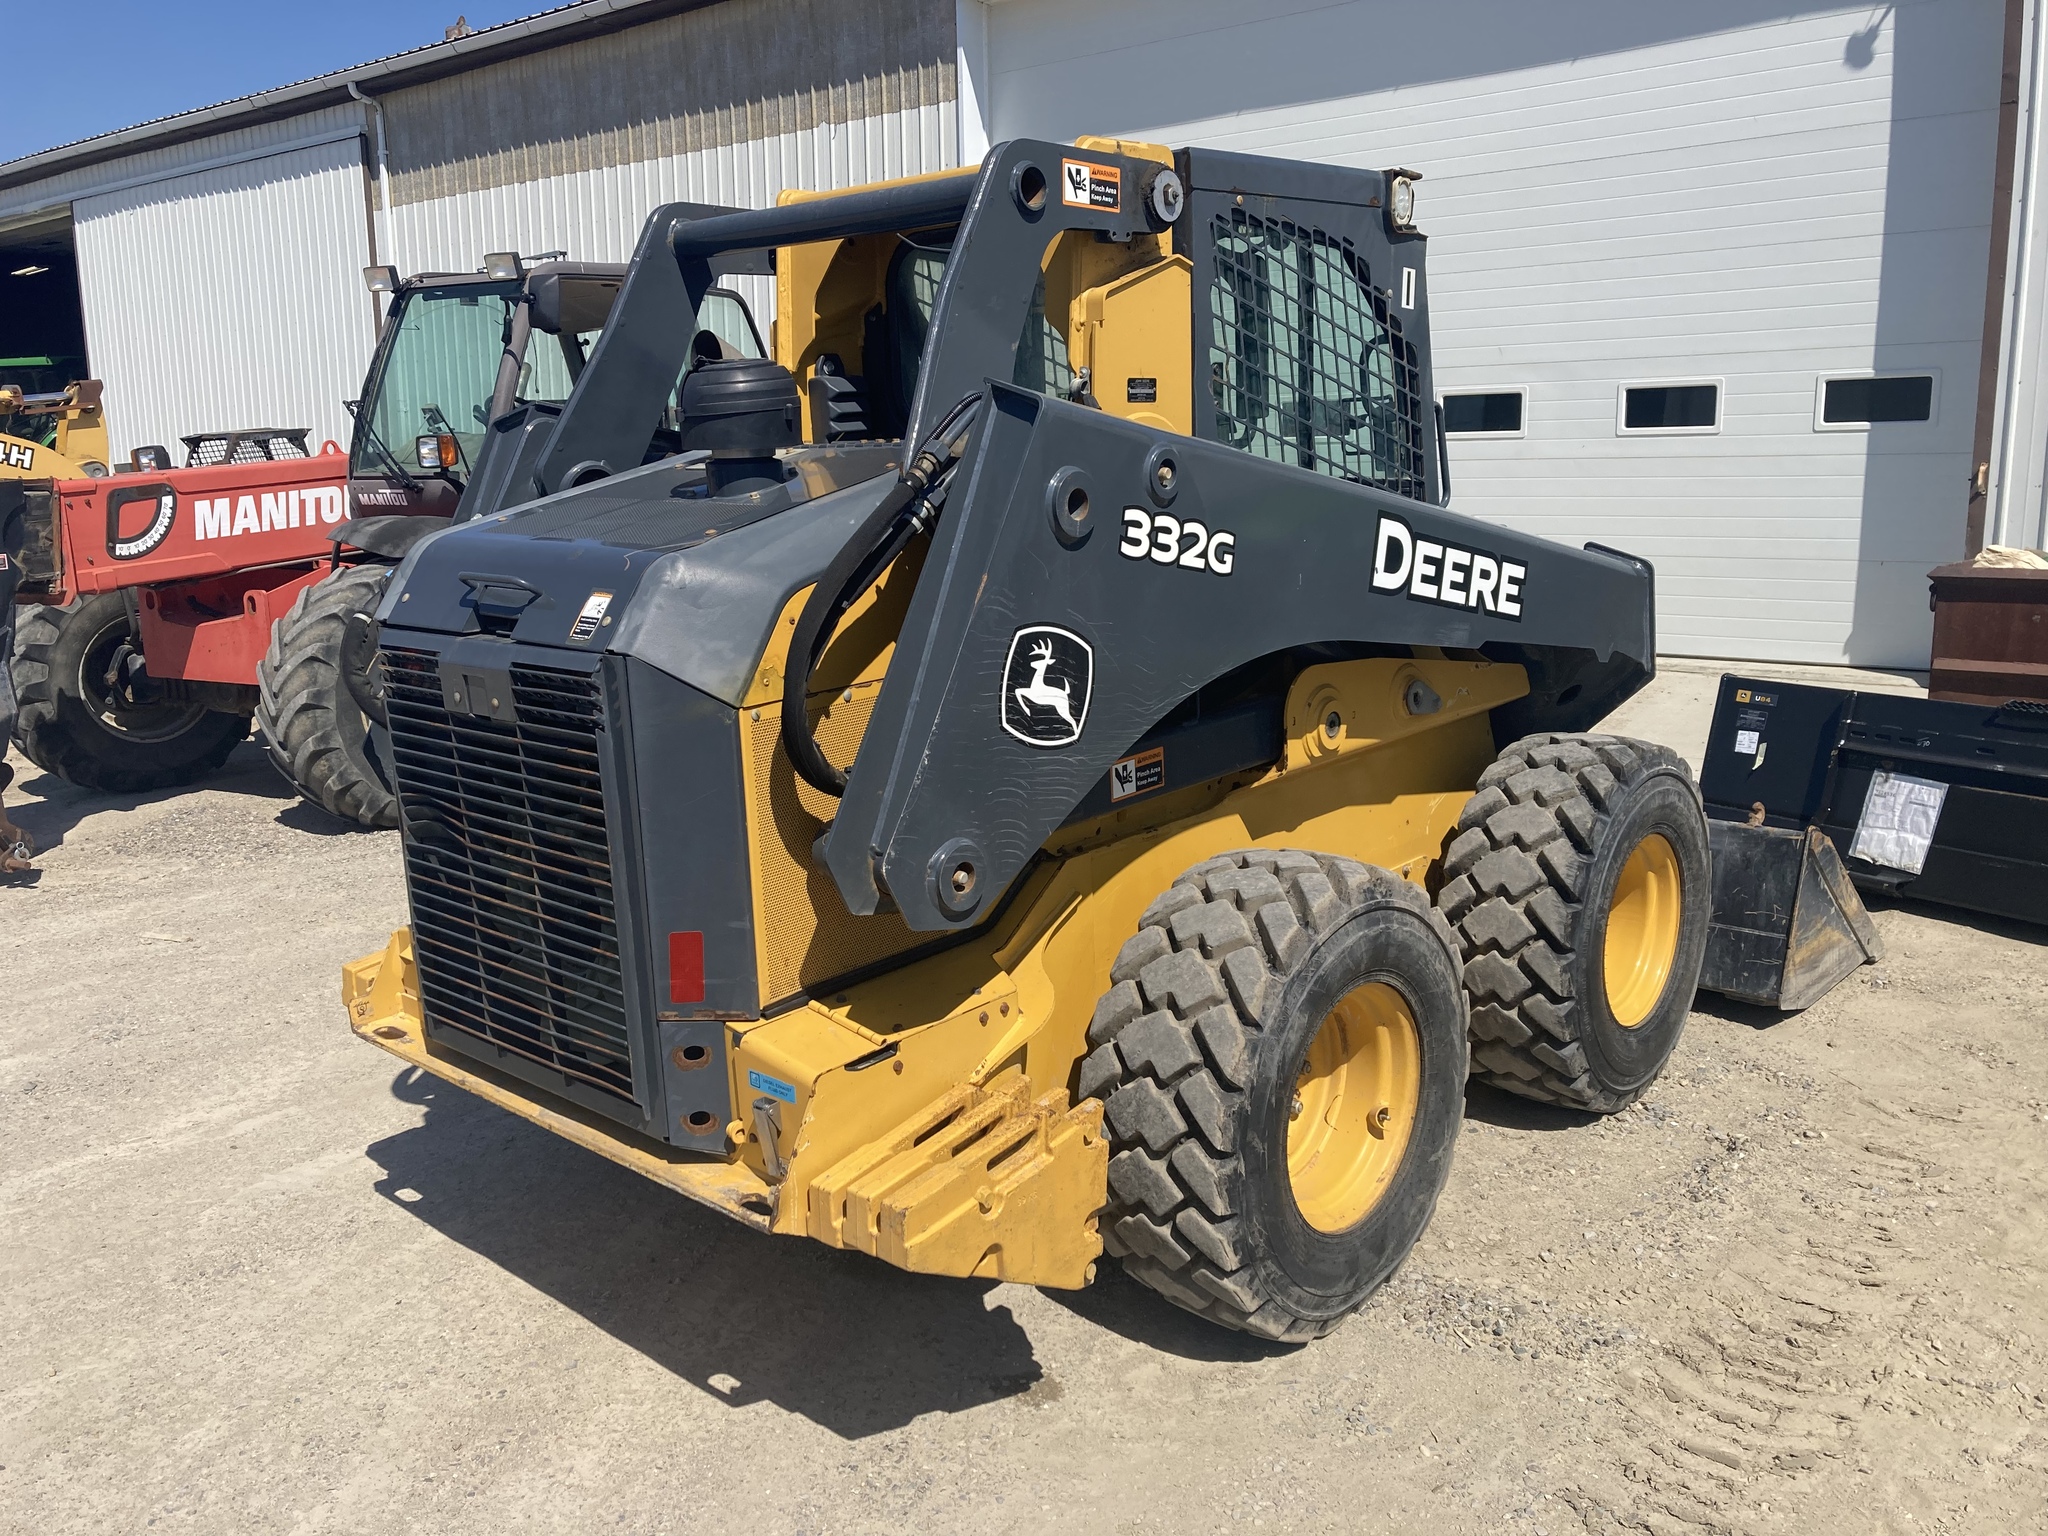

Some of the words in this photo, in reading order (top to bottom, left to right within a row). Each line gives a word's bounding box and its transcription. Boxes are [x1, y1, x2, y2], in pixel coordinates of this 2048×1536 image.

[1096, 169, 1118, 179] WARNING
[1091, 183, 1105, 193] Pinch
[1105, 186, 1117, 195] Area
[1091, 193, 1102, 202] Keep
[1102, 196, 1114, 204] Away
[358, 488, 408, 506] MANITOU
[1119, 507, 1235, 575] 332G
[1371, 516, 1527, 618] DEERE
[1150, 766, 1161, 775] Area
